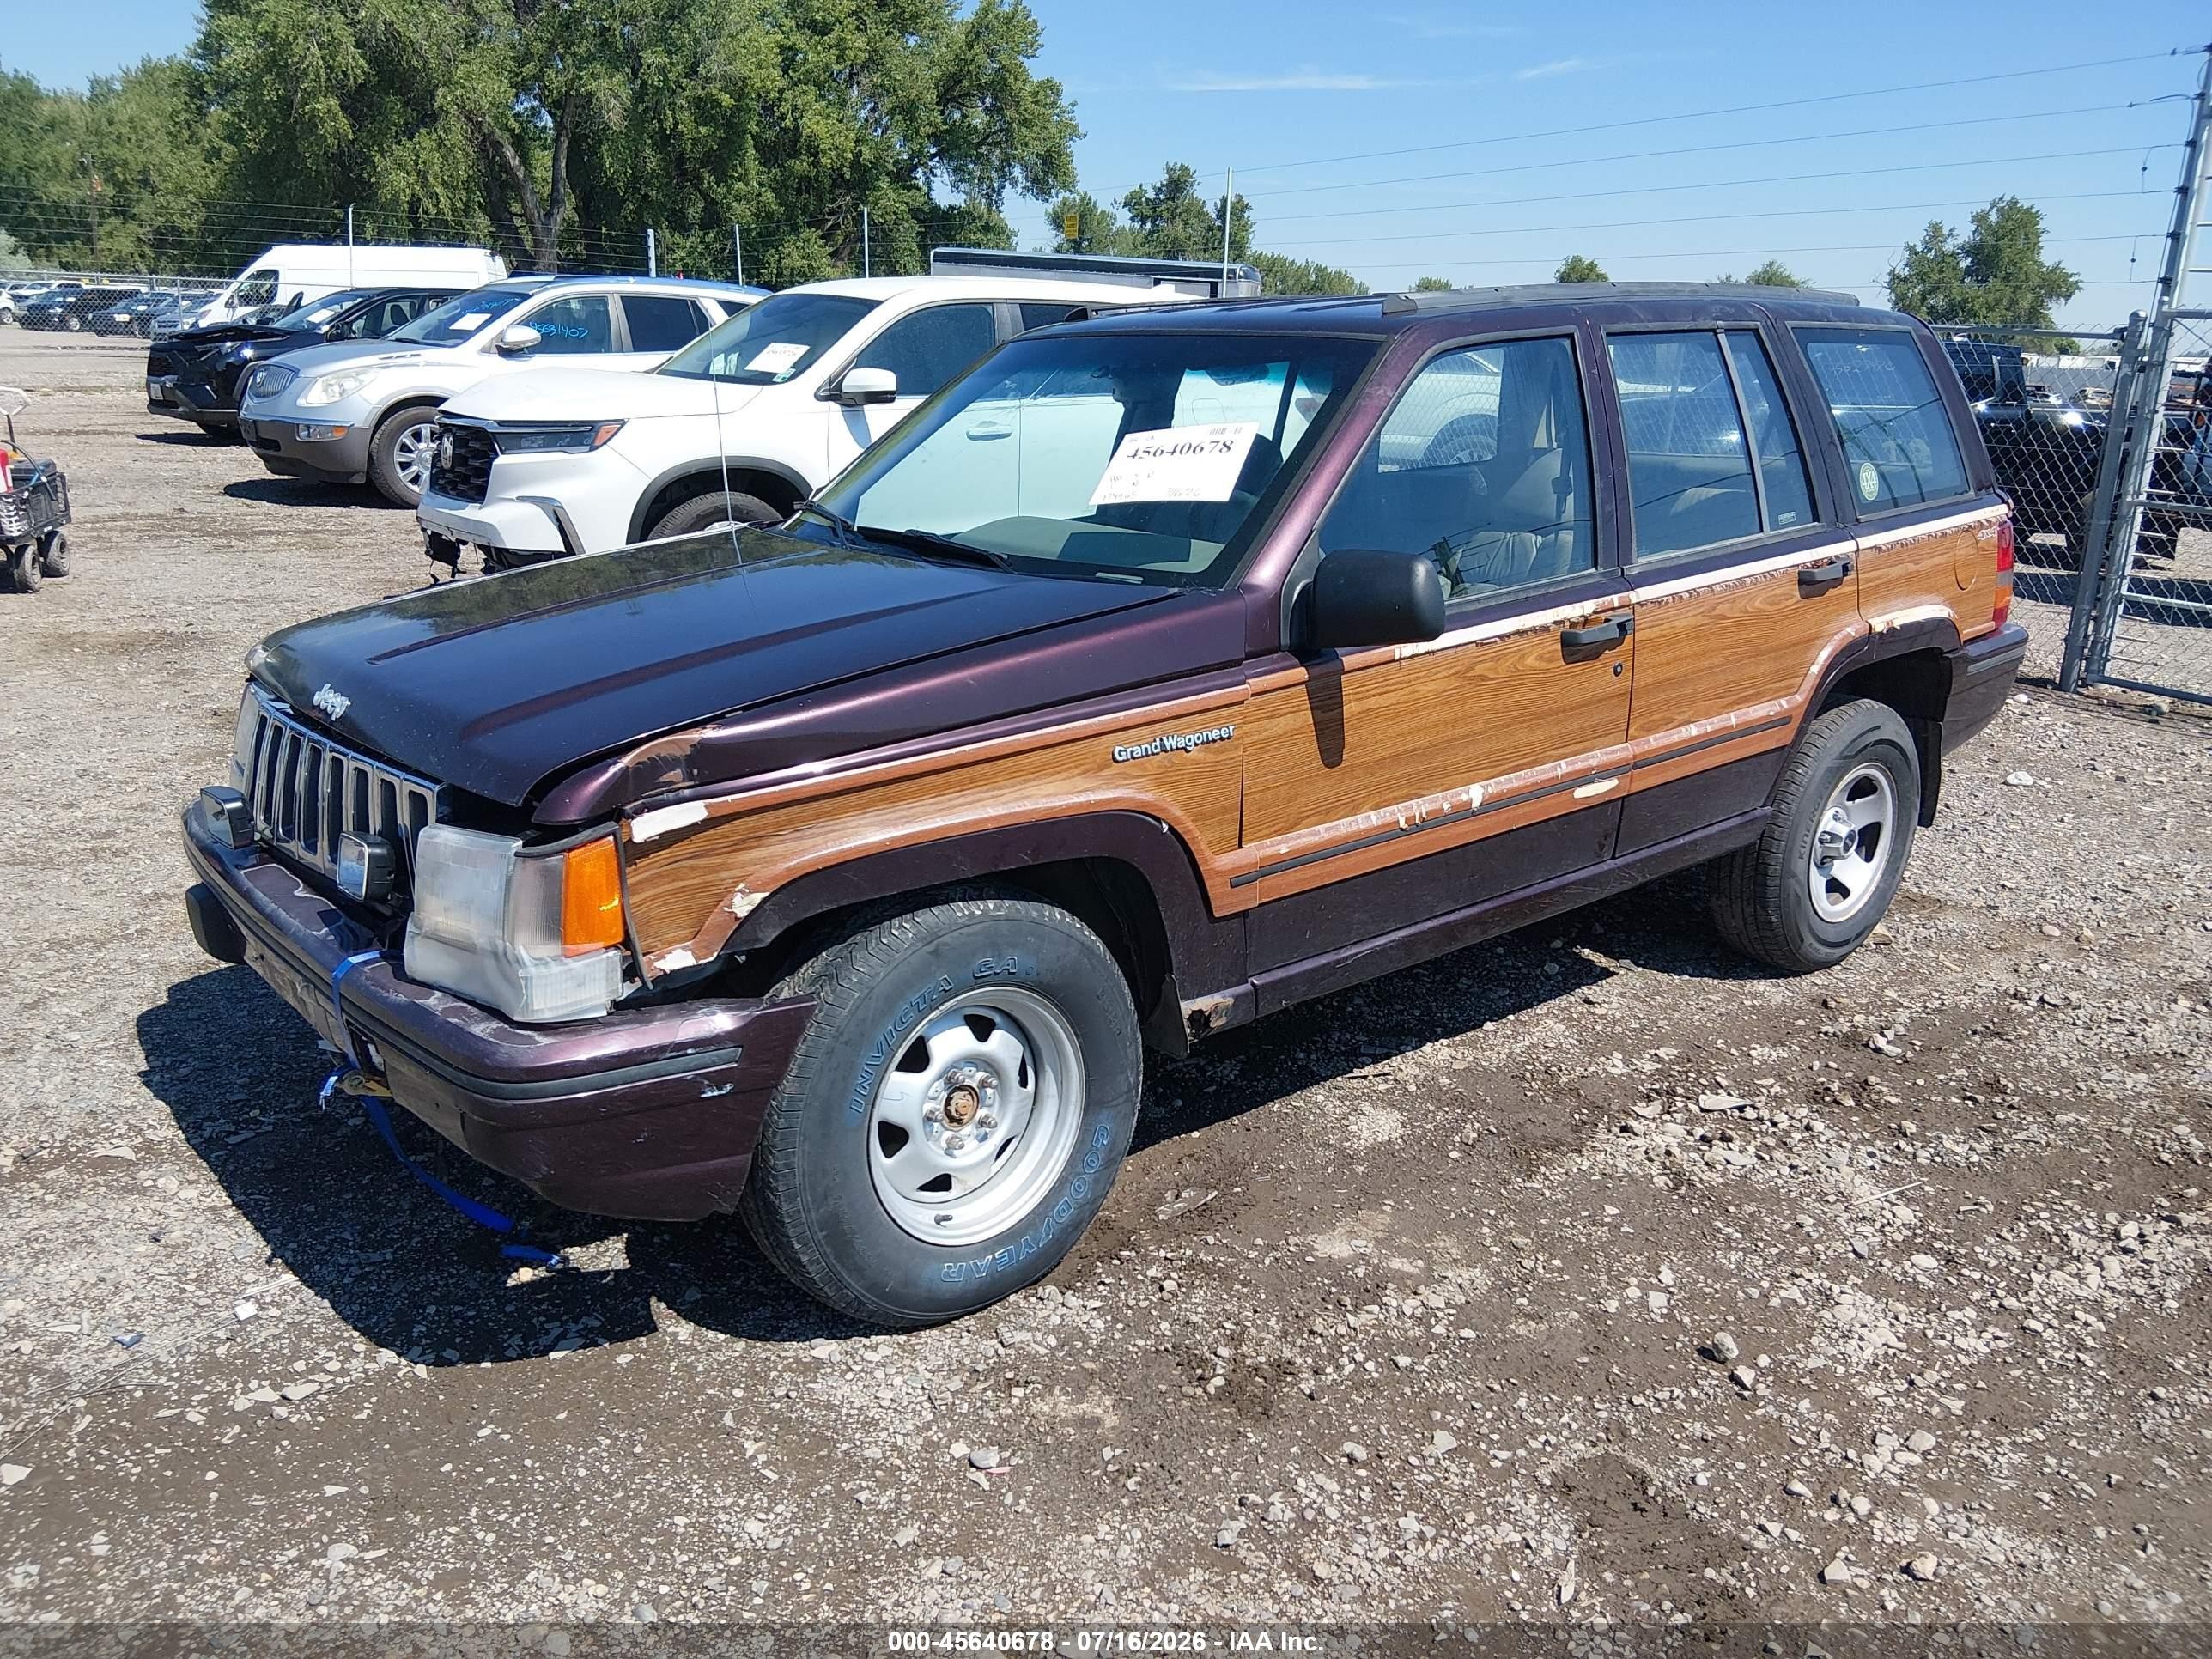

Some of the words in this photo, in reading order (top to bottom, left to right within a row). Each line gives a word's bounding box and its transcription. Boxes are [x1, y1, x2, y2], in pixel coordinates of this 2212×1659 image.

[529, 321, 589, 339] 45631407
[1127, 439, 1234, 460] 45640678
[313, 683, 351, 721] Jeep
[1112, 738, 1161, 763] Grand
[1161, 725, 1237, 752] Wagoneer
[849, 975, 955, 1115] INVICTA
[940, 1122, 1110, 1284] GOODYEAR
